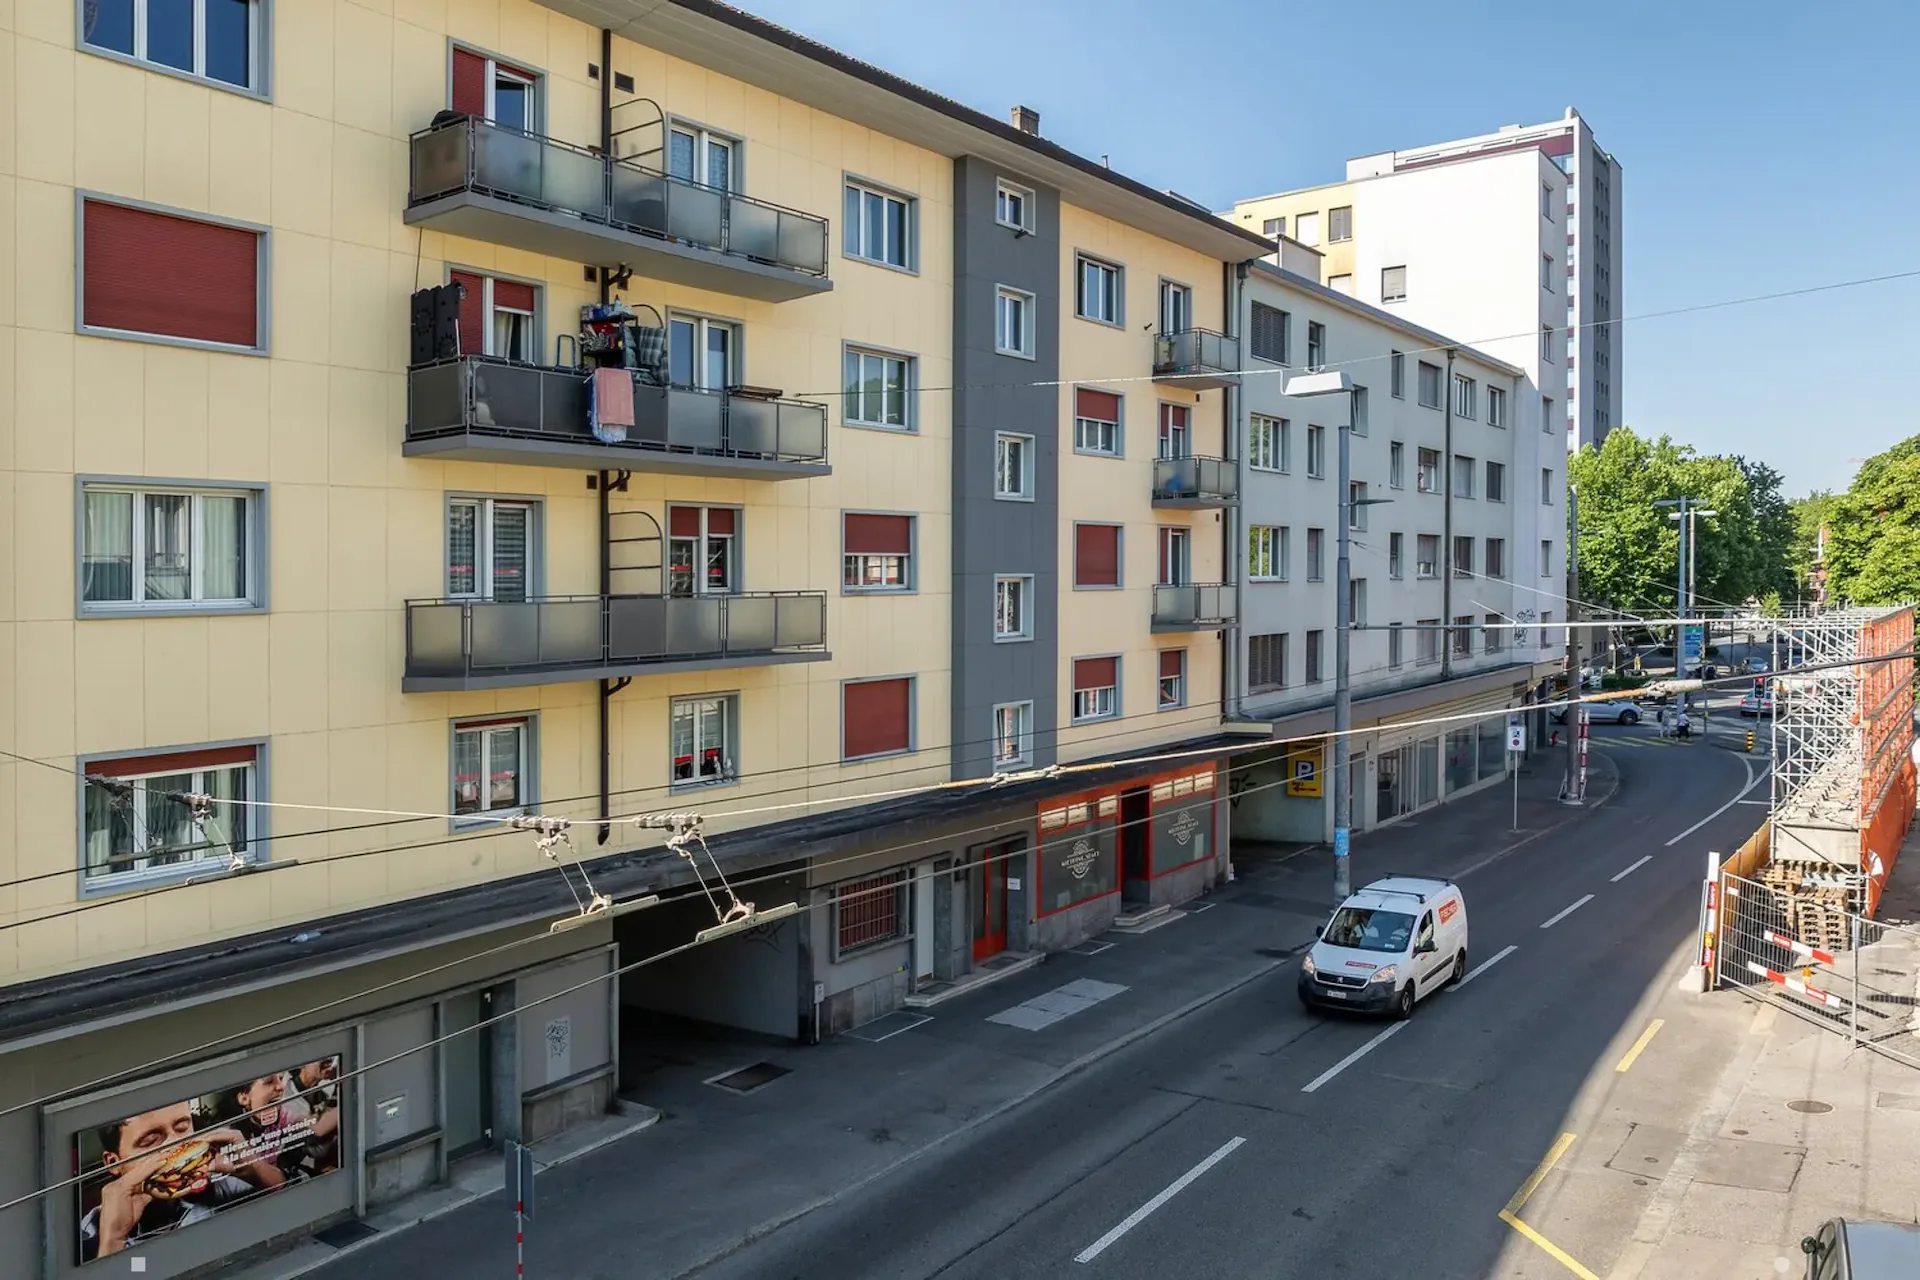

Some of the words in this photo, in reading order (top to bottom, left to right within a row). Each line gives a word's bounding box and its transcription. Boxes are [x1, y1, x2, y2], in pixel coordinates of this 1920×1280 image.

[1298, 762, 1312, 779] P
[220, 1140, 249, 1154] Mieux
[250, 1130, 281, 1147] qu'une
[283, 1118, 317, 1134] victoire
[223, 1154, 229, 1164] à
[230, 1151, 238, 1162] la
[240, 1140, 280, 1158] dernière
[281, 1129, 314, 1144] minute.
